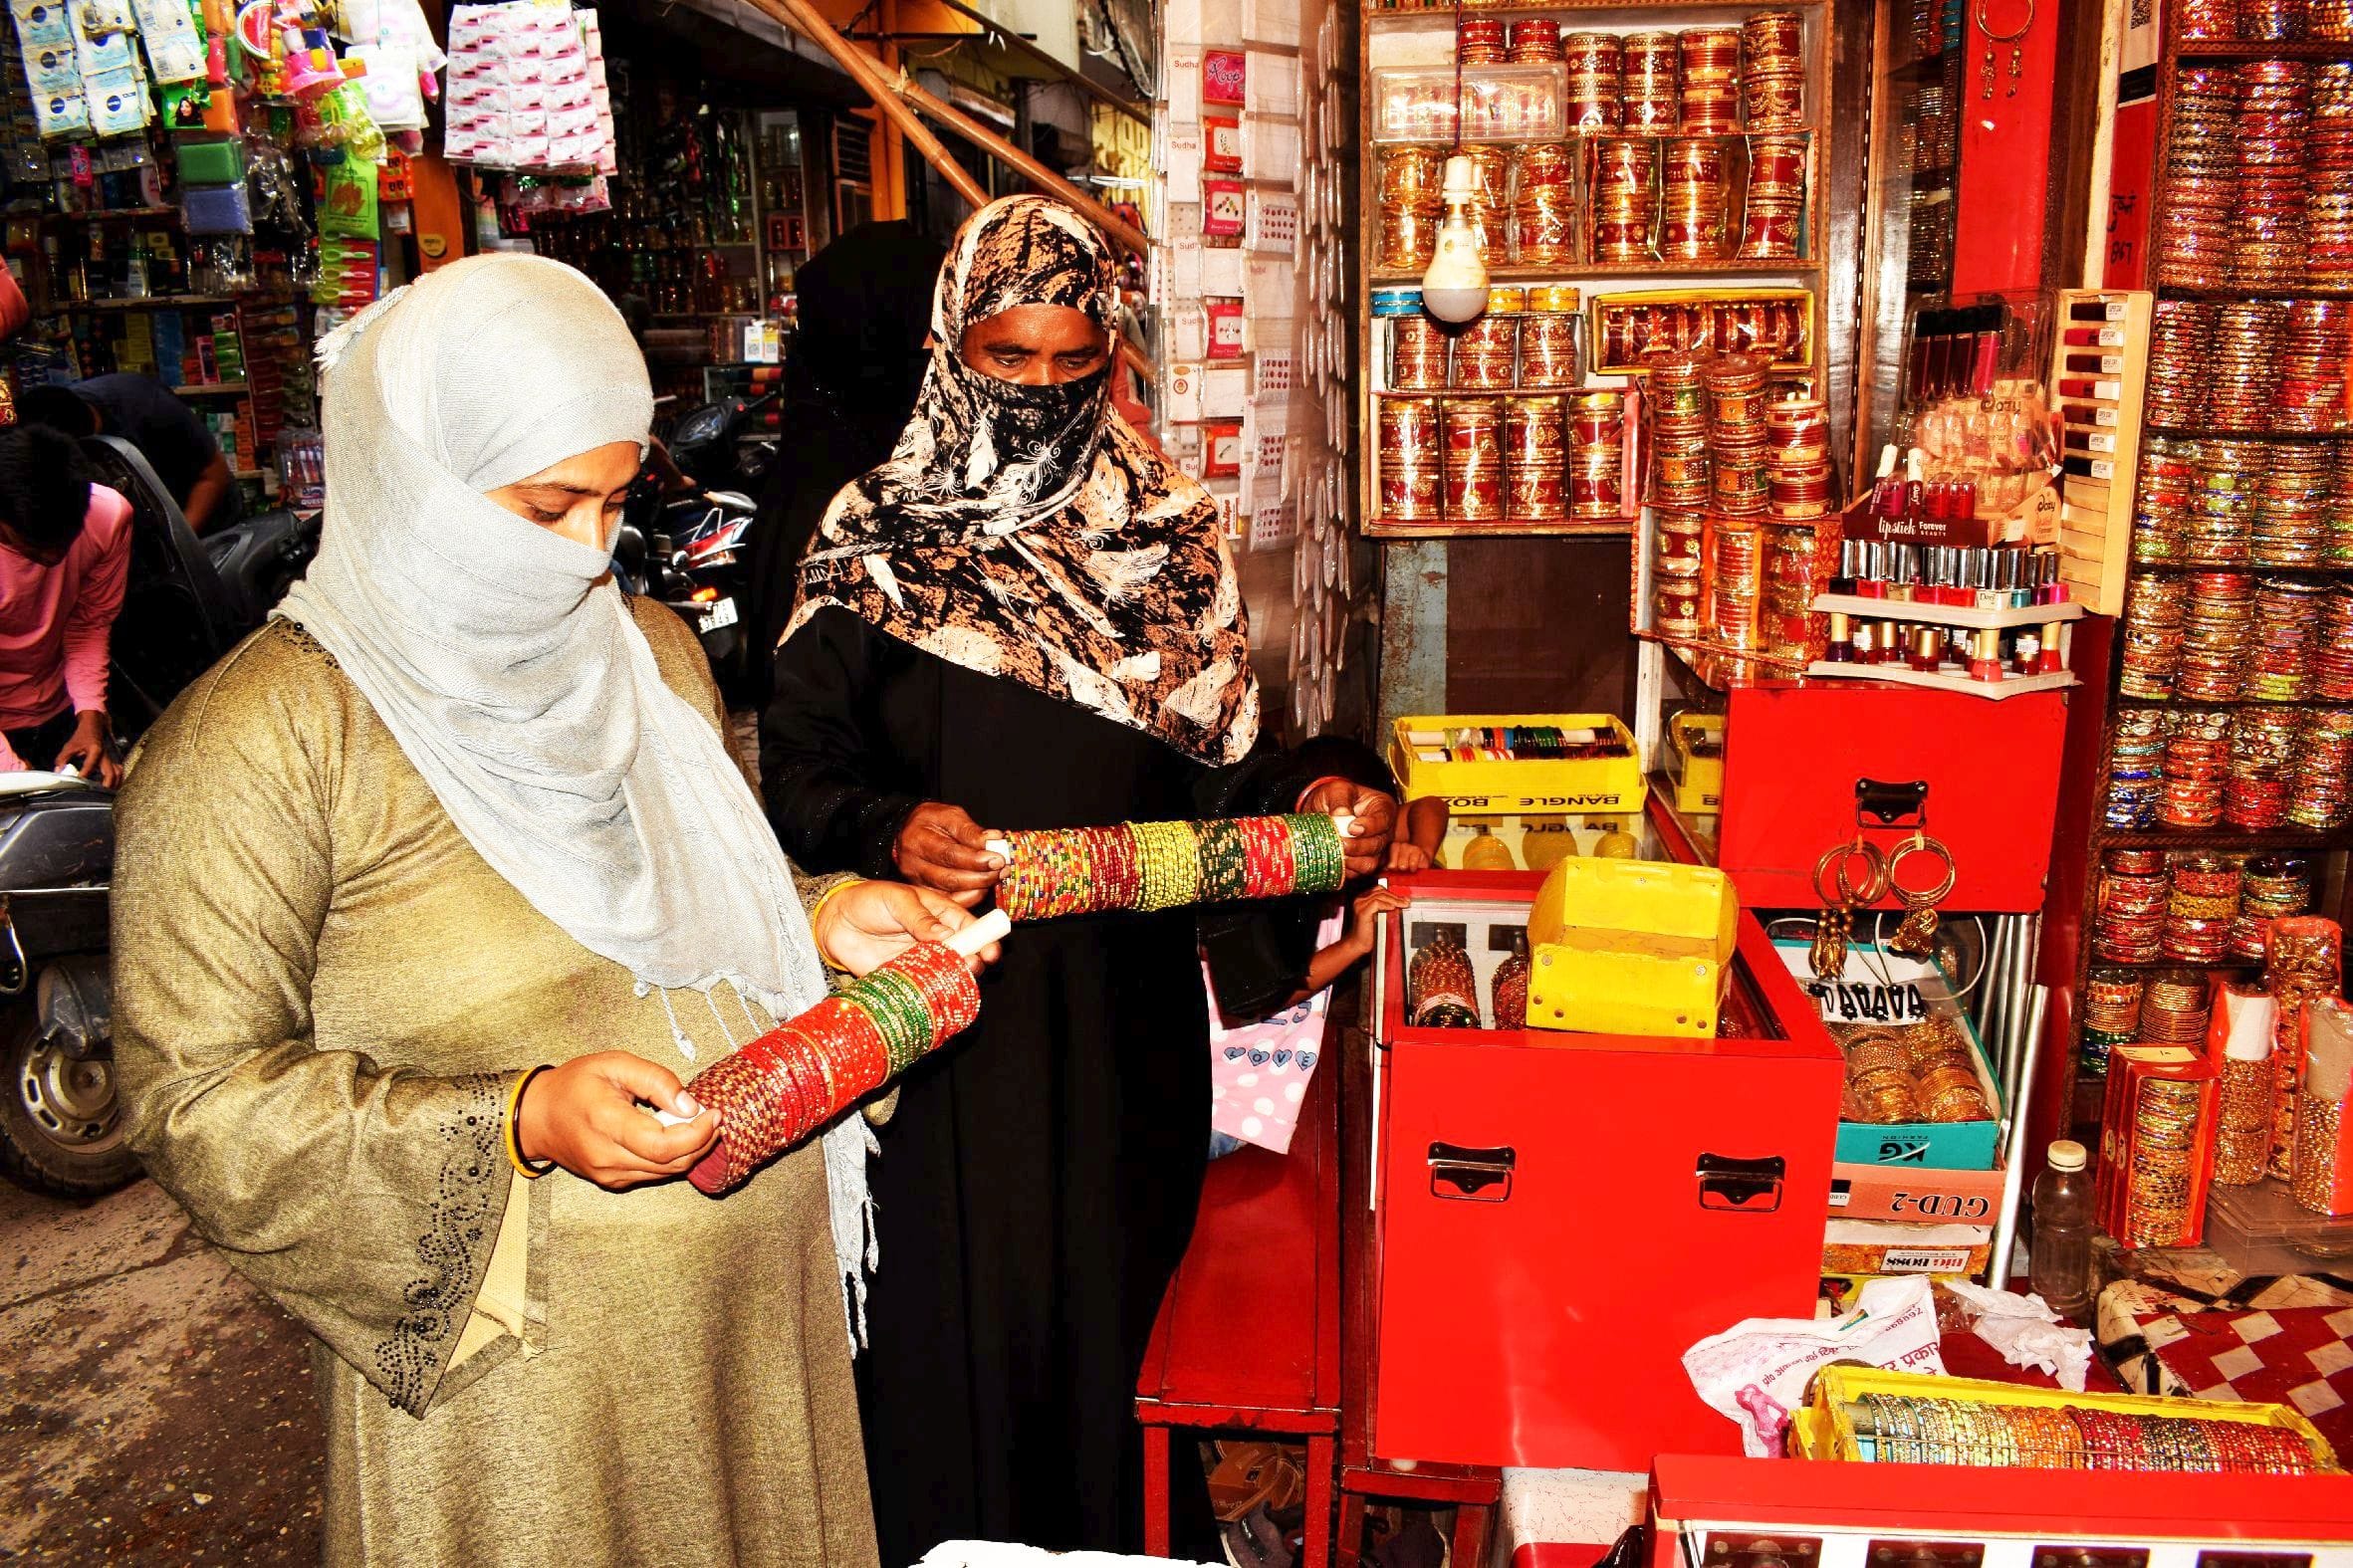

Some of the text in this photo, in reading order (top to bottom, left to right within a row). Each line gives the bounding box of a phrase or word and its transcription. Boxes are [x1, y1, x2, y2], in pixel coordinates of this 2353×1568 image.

[1174, 60, 1199, 69] Sudha
[1171, 140, 1197, 149] Sudha
[1878, 516, 1947, 541] lipstick Forever
[1520, 795, 1619, 806] BANGLE
[1229, 1050, 1310, 1067] LOVE
[1878, 1142, 1926, 1163] KG
[1890, 1192, 1990, 1219] GUD-2
[1886, 1256, 1930, 1267] BOSS
